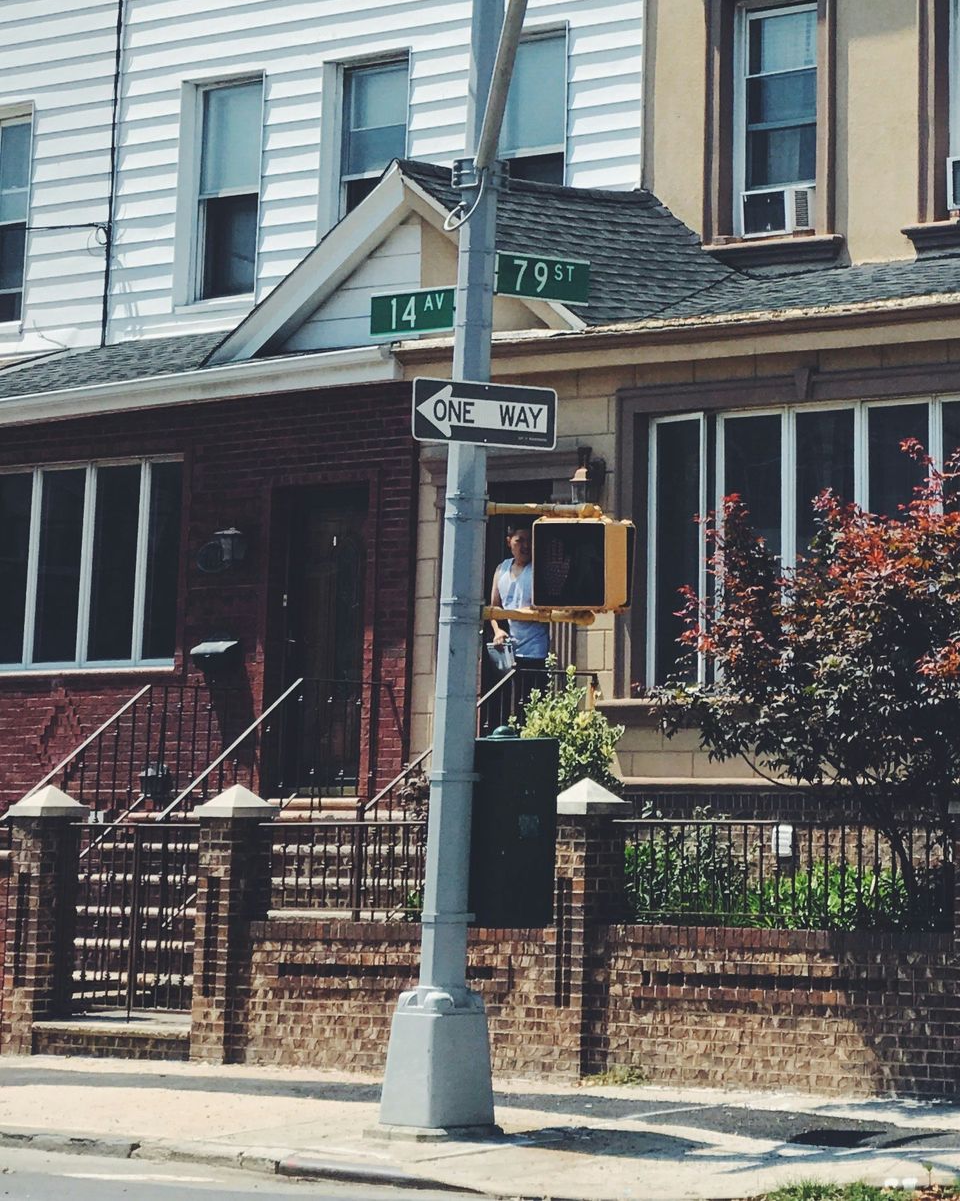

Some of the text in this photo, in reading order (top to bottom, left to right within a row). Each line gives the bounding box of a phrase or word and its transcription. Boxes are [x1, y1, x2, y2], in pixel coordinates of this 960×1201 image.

[513, 259, 575, 293] 79 ST
[391, 293, 444, 329] 14 AV
[433, 399, 543, 429] ONE WAY
